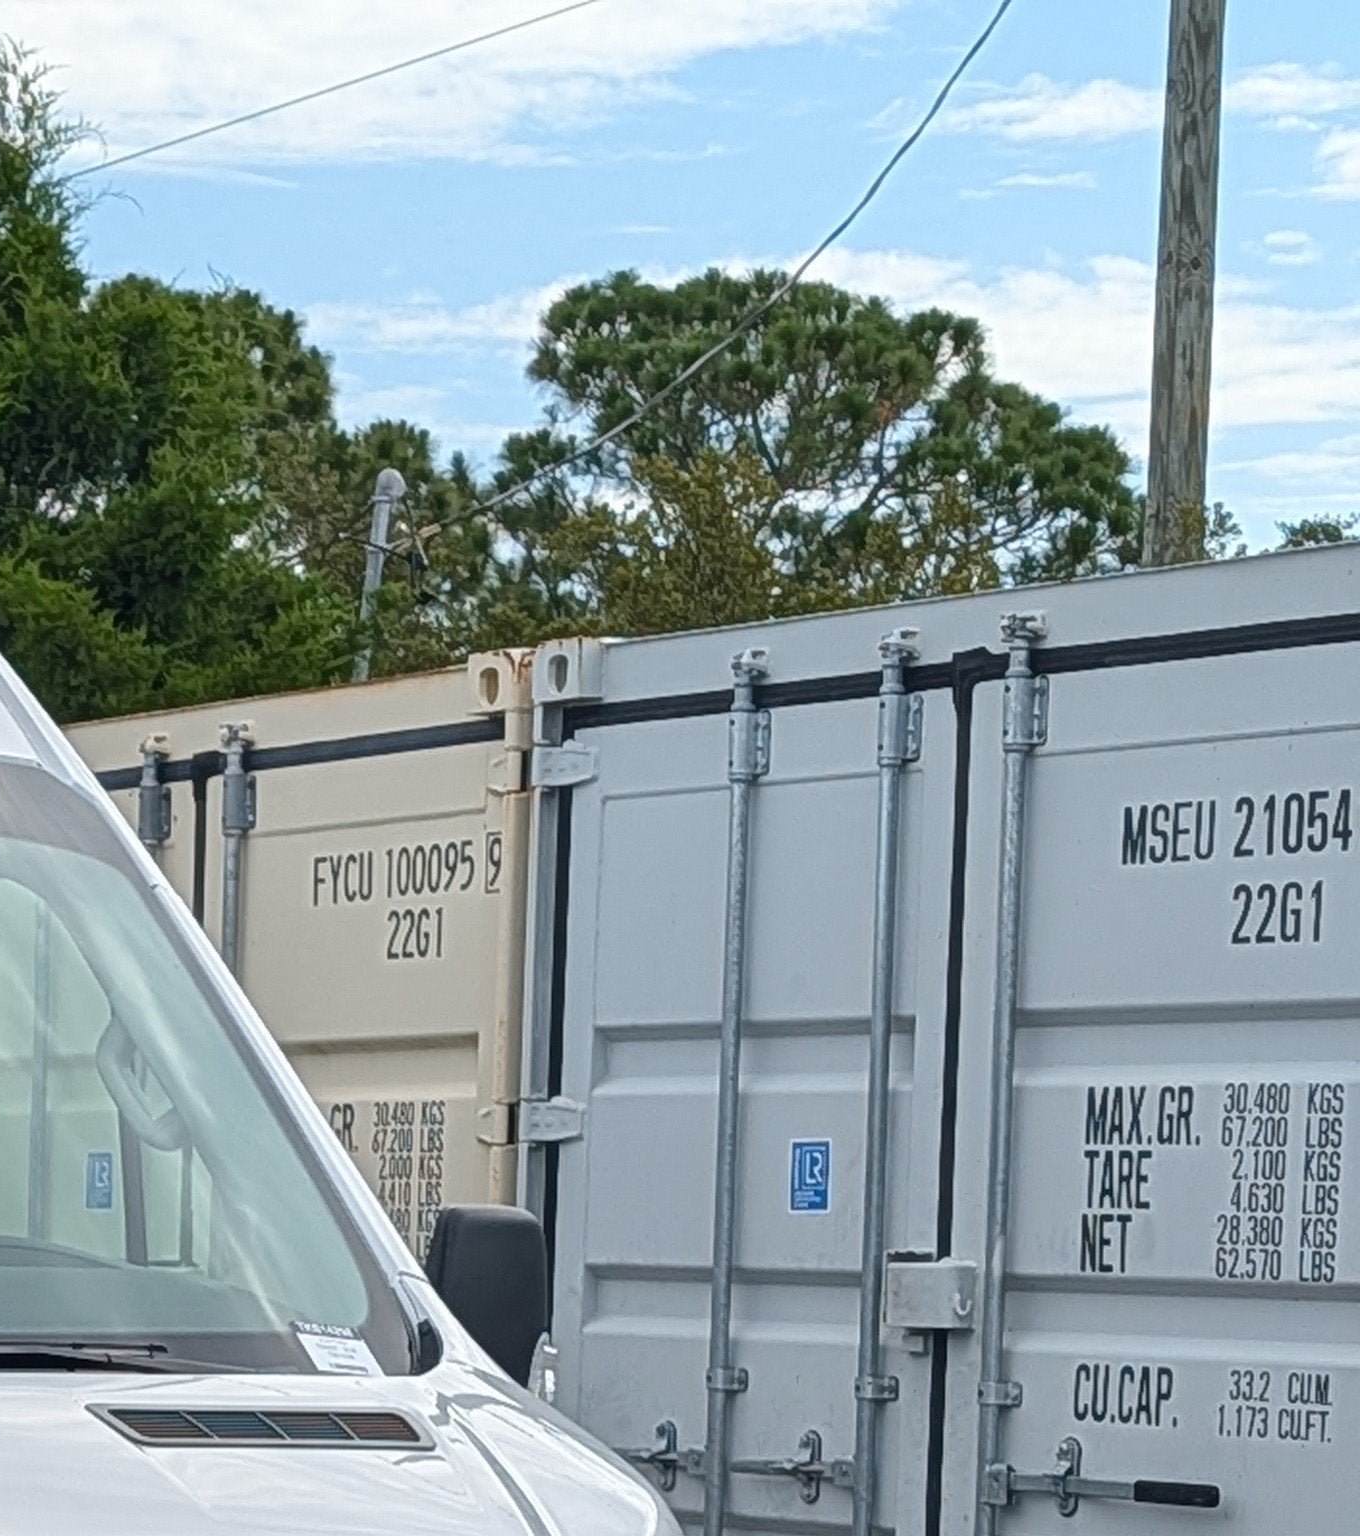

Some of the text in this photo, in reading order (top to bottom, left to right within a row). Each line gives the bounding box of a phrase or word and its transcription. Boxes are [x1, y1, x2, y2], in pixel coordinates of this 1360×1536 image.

[1121, 788, 1353, 865] MSEU 21054
[312, 850, 373, 907] FYCU
[384, 839, 475, 899] 100095
[385, 906, 443, 960] 22G1
[1230, 879, 1323, 945] 22G1
[1084, 1082, 1344, 1146] MAX.GR. 30.480 KGS
[1220, 1115, 1343, 1149] 67.200 LBS
[1083, 1148, 1341, 1209] TARE 2.100 KGS
[1230, 1182, 1340, 1216] 4.630 LBS
[1079, 1213, 1338, 1273] NET 28.380 KGS
[1215, 1246, 1336, 1283] 62.570 LBS
[1073, 1363, 1178, 1428] CU.CAP.
[1229, 1369, 1271, 1402] 33.2
[1218, 1404, 1269, 1438] 1.173
